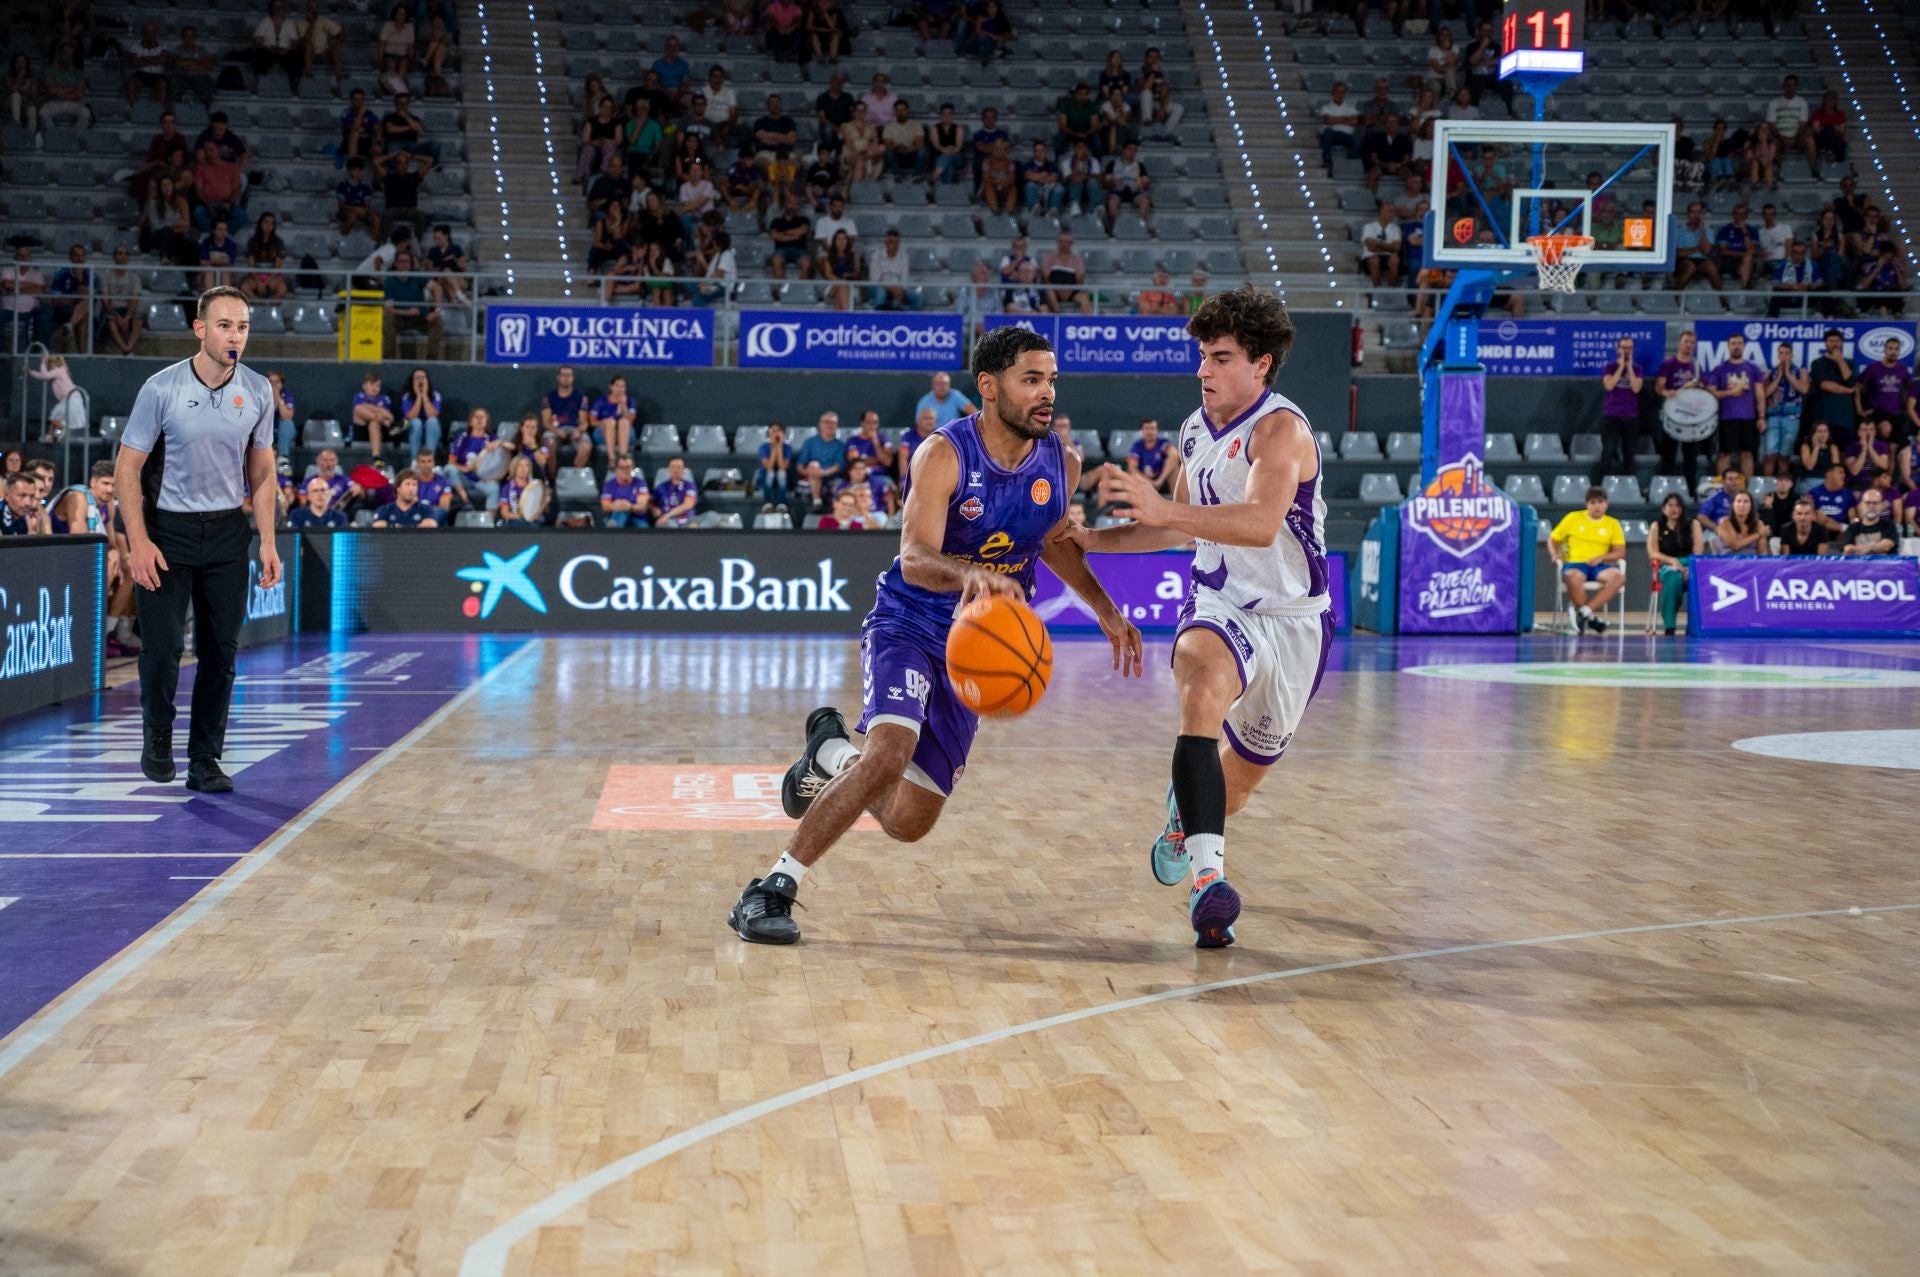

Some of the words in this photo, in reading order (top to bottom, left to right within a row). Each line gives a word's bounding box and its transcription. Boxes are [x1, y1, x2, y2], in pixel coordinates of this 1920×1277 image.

[1526, 11, 1571, 48] 11
[536, 312, 704, 339] POLICLÍNICA
[1065, 326, 1117, 340] sara
[1125, 327, 1193, 341] varas
[567, 338, 673, 359] DENTAL
[1131, 343, 1190, 362] dental
[1515, 345, 1555, 358] DANI
[1573, 341, 1618, 349] COMIDA
[1415, 496, 1506, 520] PALENCIA
[559, 555, 851, 611] CaixaBank
[1430, 567, 1483, 592] JUEGA
[1766, 578, 1916, 601] ARAMBOL
[1419, 583, 1497, 611] PALENCIA
